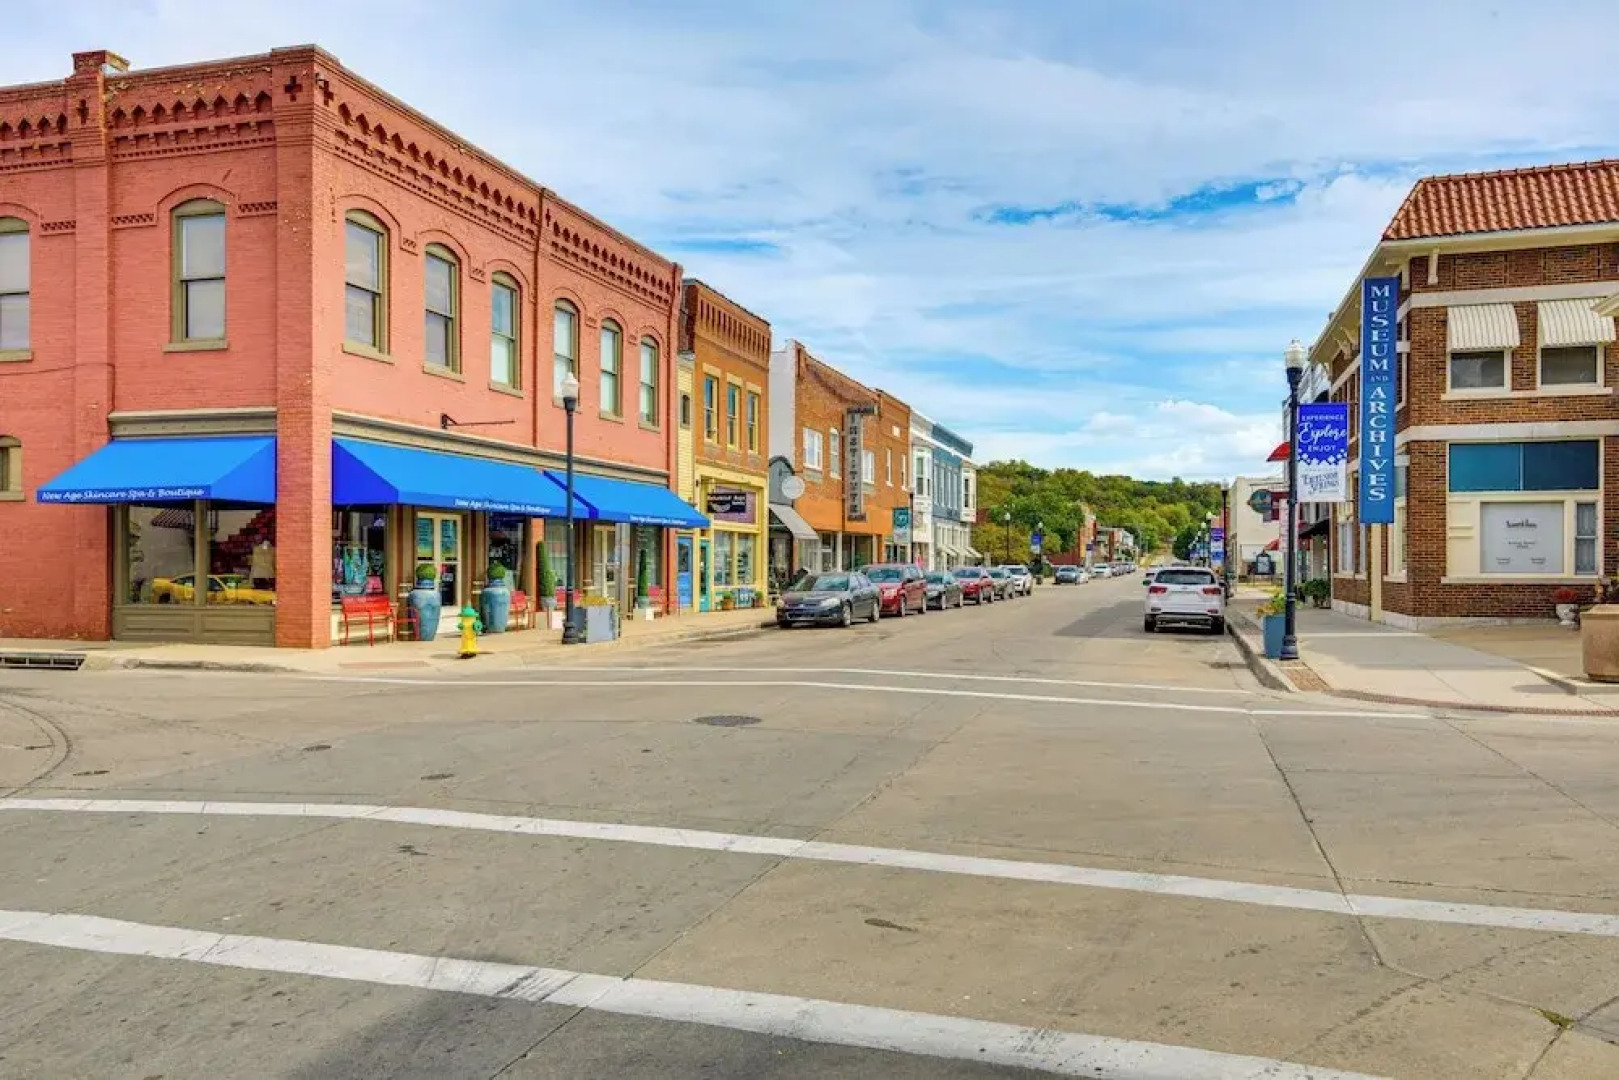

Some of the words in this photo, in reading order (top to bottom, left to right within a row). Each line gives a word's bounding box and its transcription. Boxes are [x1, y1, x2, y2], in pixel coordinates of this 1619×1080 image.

[1369, 284, 1390, 371] MUSEUM
[1299, 422, 1347, 446] Explore
[1367, 386, 1387, 502] ARCHIVES
[1307, 444, 1337, 453] ENJOY
[41, 491, 60, 500] New
[63, 491, 82, 502] Age
[83, 489, 126, 500] Skincare
[129, 489, 146, 501] Spa
[148, 489, 156, 499] &
[158, 488, 205, 500] Boutique
